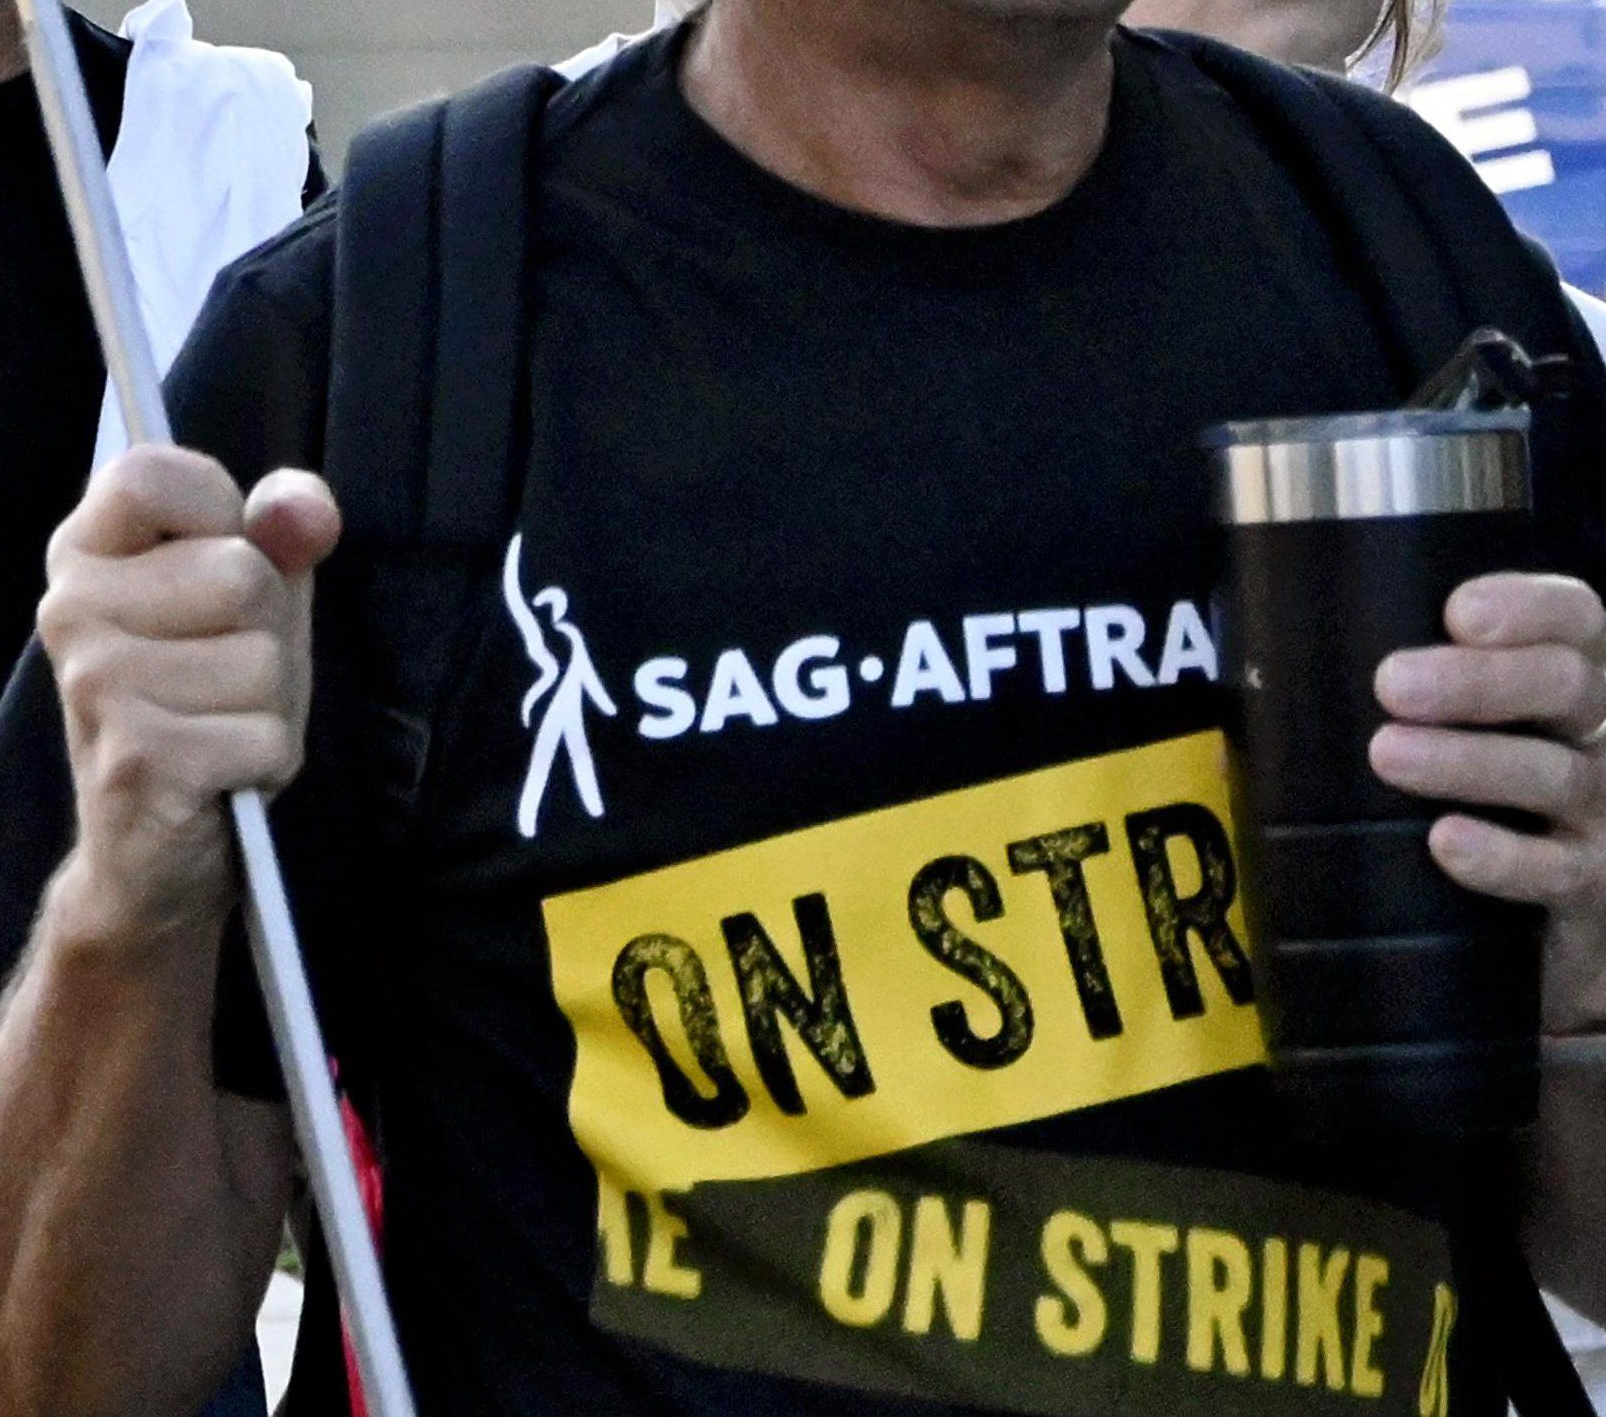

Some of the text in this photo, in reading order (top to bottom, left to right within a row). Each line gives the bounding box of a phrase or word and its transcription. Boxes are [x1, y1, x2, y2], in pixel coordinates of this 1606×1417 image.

[610, 892, 877, 1129] ON
[819, 1189, 990, 1342] ON
[1034, 1209, 1389, 1398] STRIKE
